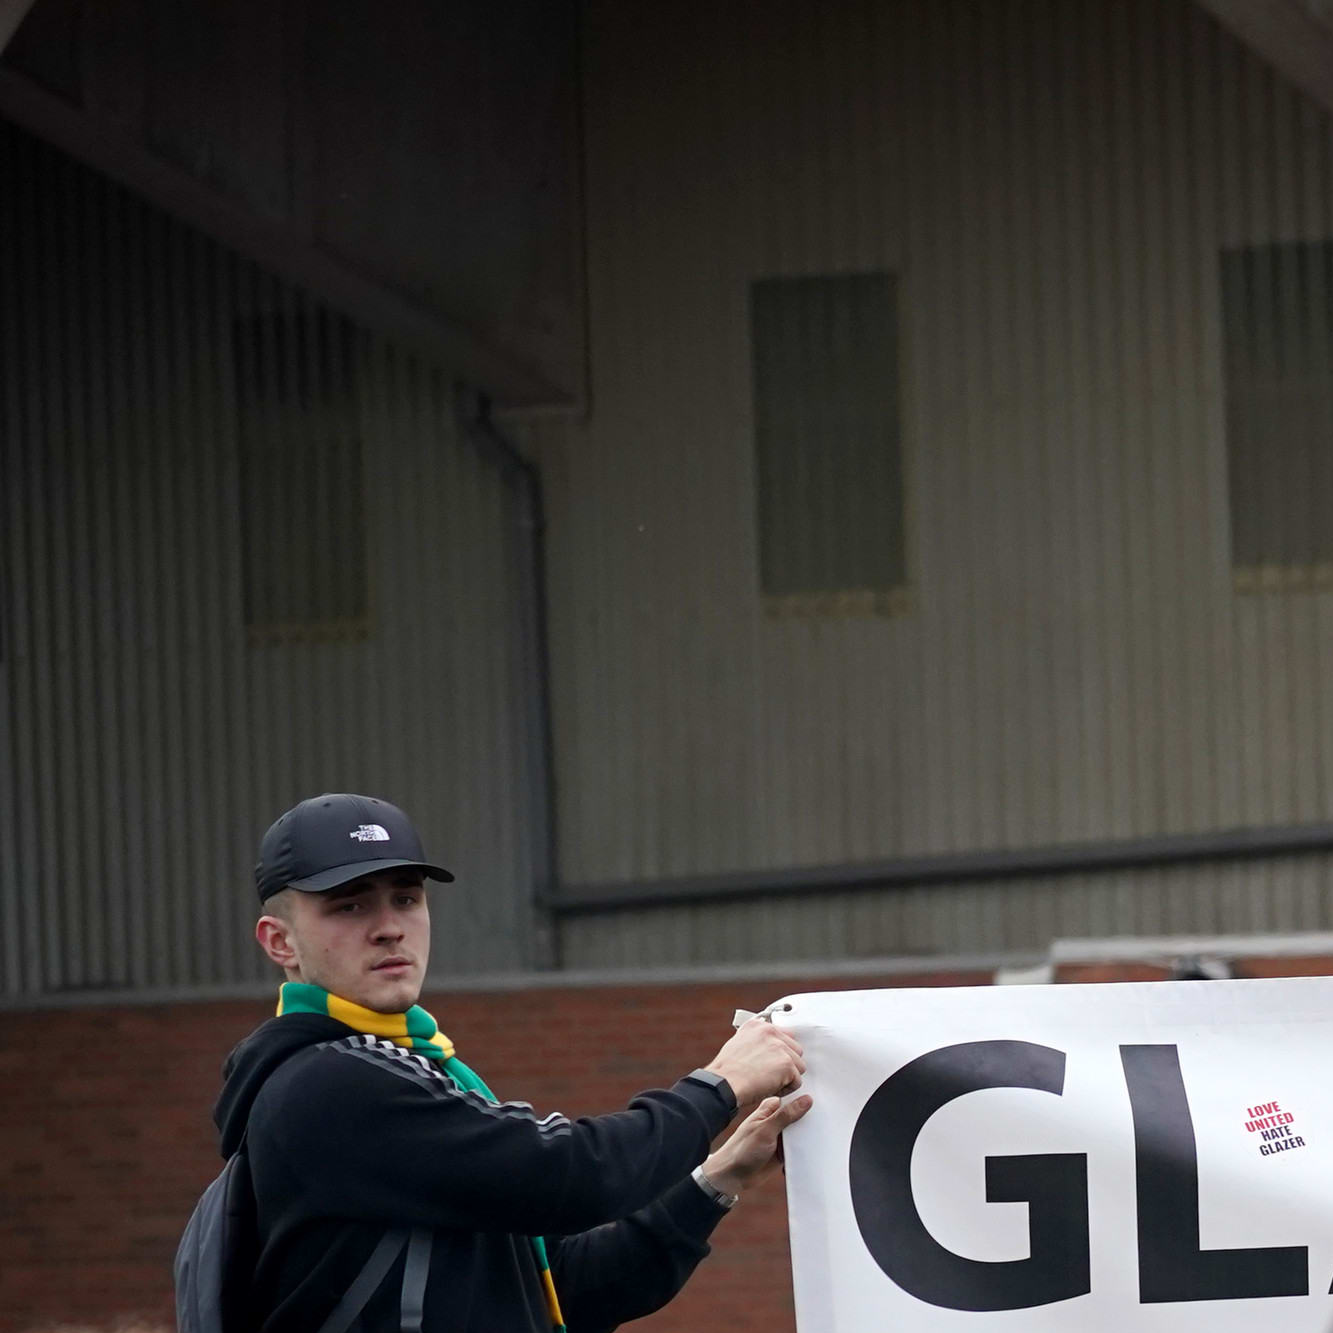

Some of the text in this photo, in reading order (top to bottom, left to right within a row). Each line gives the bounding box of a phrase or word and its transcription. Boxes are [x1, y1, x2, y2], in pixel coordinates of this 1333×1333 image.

[1247, 1101, 1281, 1118] LOVE
[1244, 1112, 1294, 1132] UNITED
[1260, 1125, 1293, 1141] HATE
[1259, 1136, 1306, 1156] GLAZER
